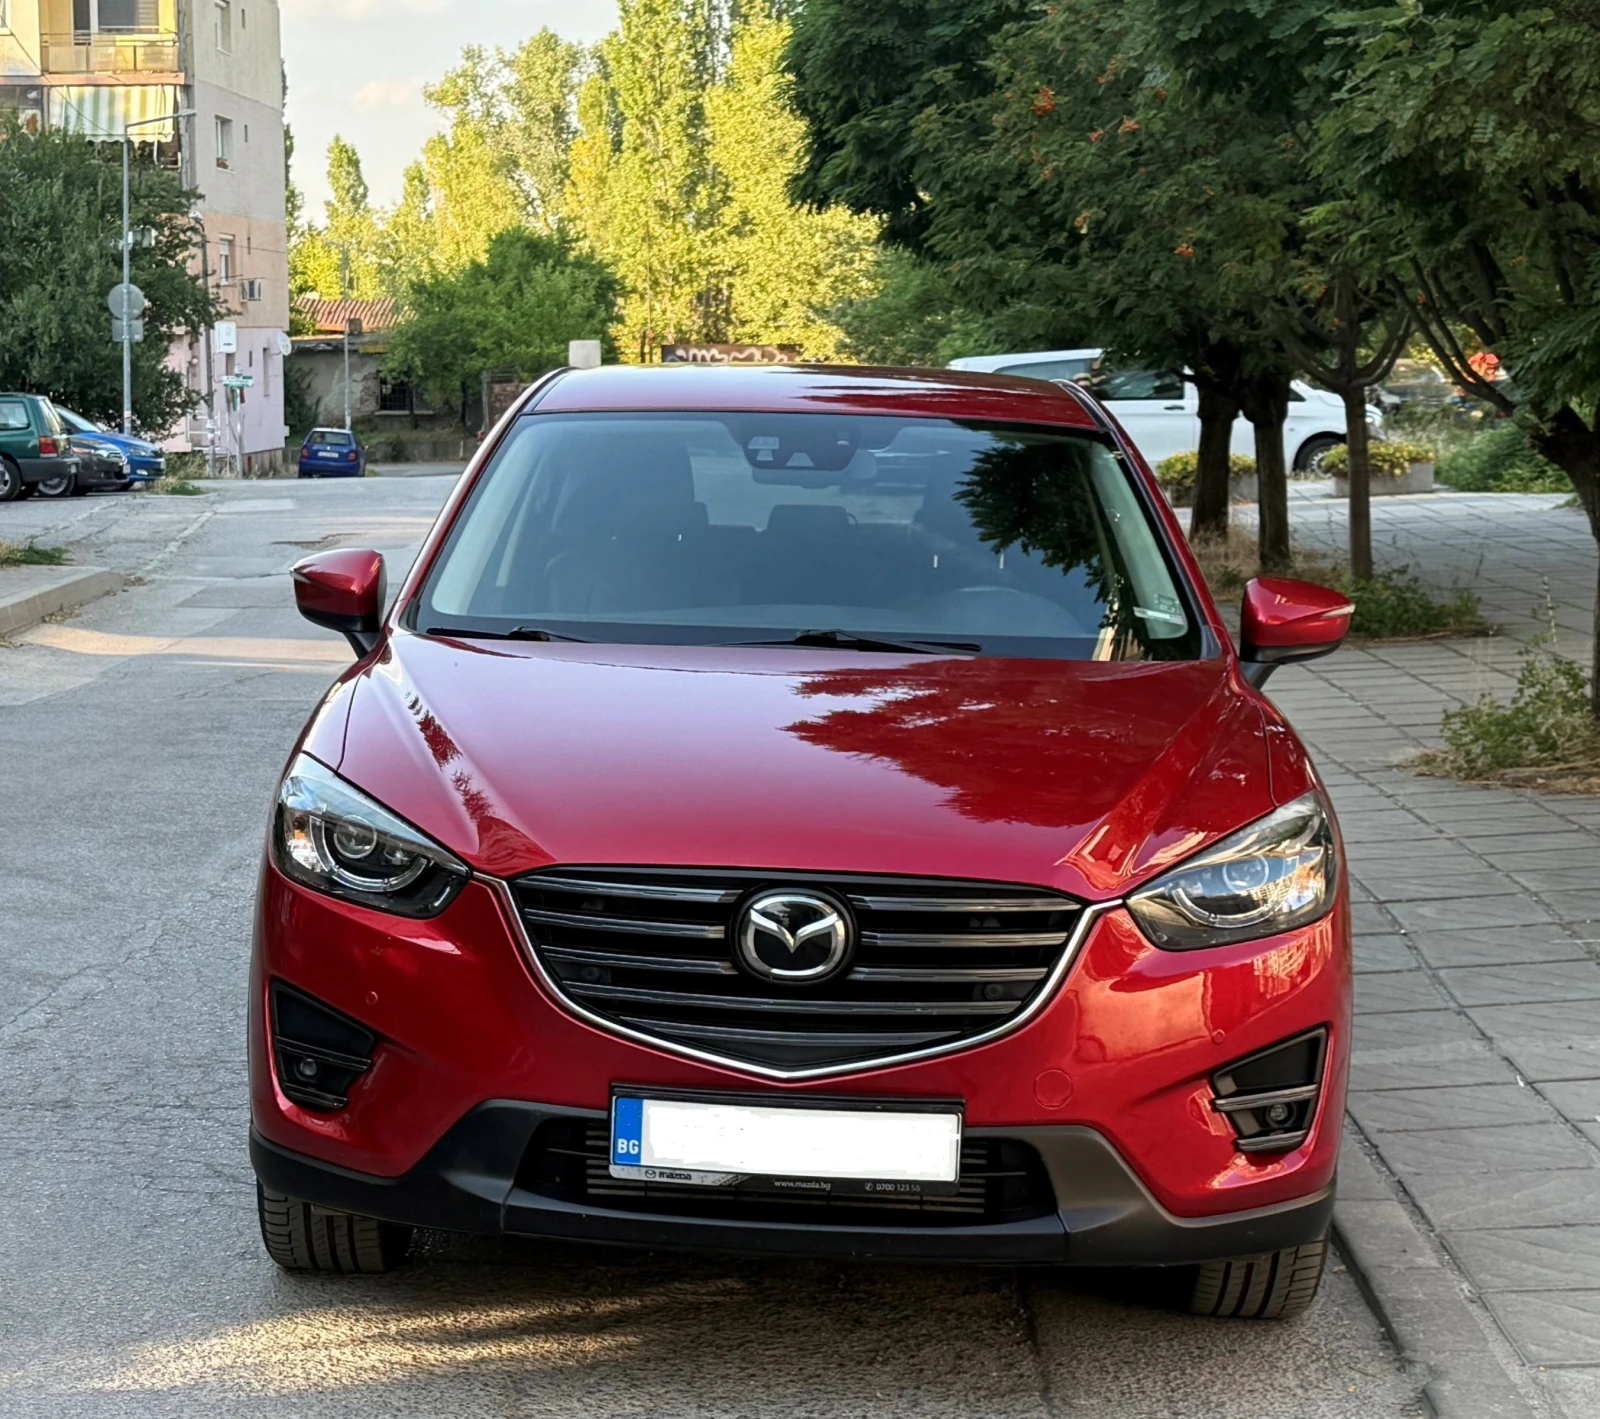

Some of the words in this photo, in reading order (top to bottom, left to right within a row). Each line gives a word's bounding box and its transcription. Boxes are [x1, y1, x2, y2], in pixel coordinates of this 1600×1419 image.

[617, 1138, 639, 1155] BG
[658, 1171, 692, 1181] mazda
[773, 1180, 831, 1191] www.mazda.bg
[876, 1182, 895, 1191] 0700
